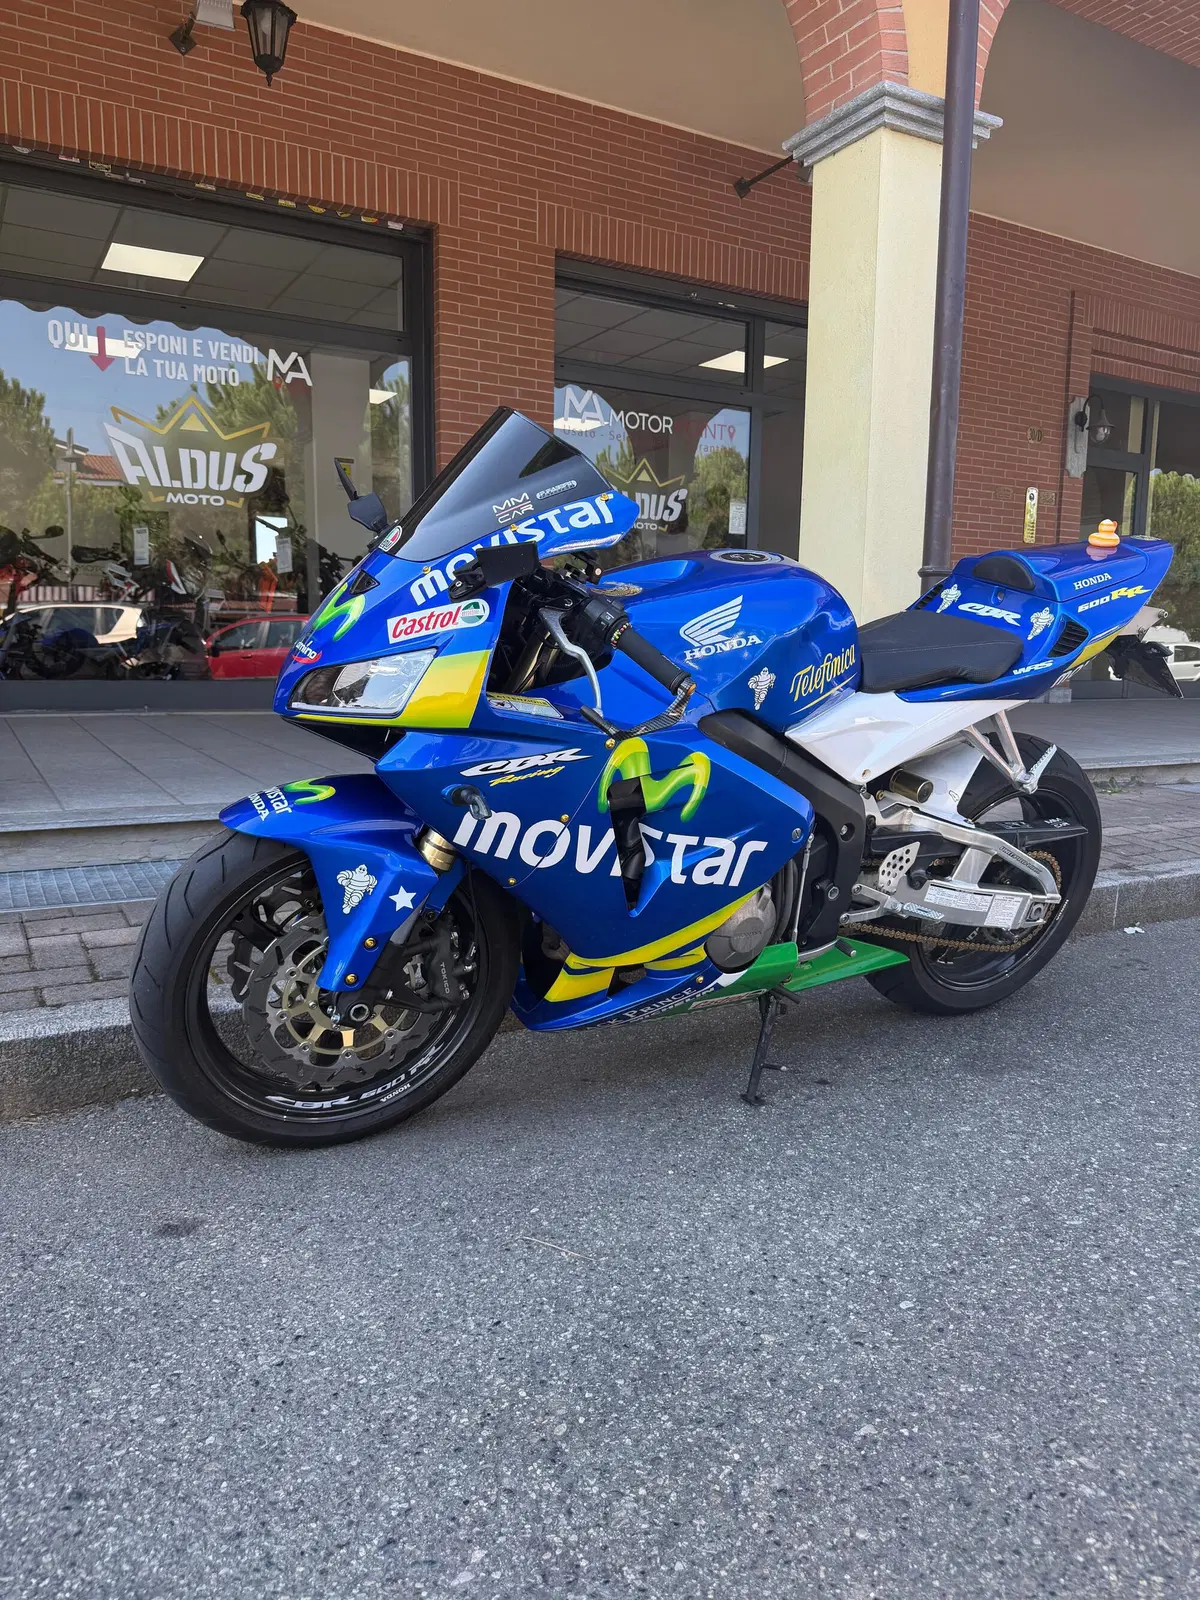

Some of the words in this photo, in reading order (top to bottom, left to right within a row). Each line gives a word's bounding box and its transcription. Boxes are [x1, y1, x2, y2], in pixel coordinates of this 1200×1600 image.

[48, 319, 89, 350] QUI
[123, 329, 188, 357] ESPONI
[193, 338, 203, 357] E
[208, 339, 259, 365] VENDI
[124, 356, 148, 377] LA
[152, 359, 188, 381] TUA
[193, 363, 240, 387] MOTO
[608, 410, 674, 435] MOTOR
[103, 422, 278, 494] ALDUS
[165, 492, 225, 507] MOTO
[497, 503, 535, 524] CAR
[1073, 572, 1113, 591] HONDA
[391, 609, 462, 641] Castrol
[957, 602, 1022, 627] CBR
[684, 634, 764, 662] HONDA
[460, 748, 593, 777] CBR
[440, 961, 451, 994] TOKICO
[625, 986, 698, 1019] PRINCE
[359, 1073, 406, 1101] 600
[379, 1082, 411, 1103] HONDA
